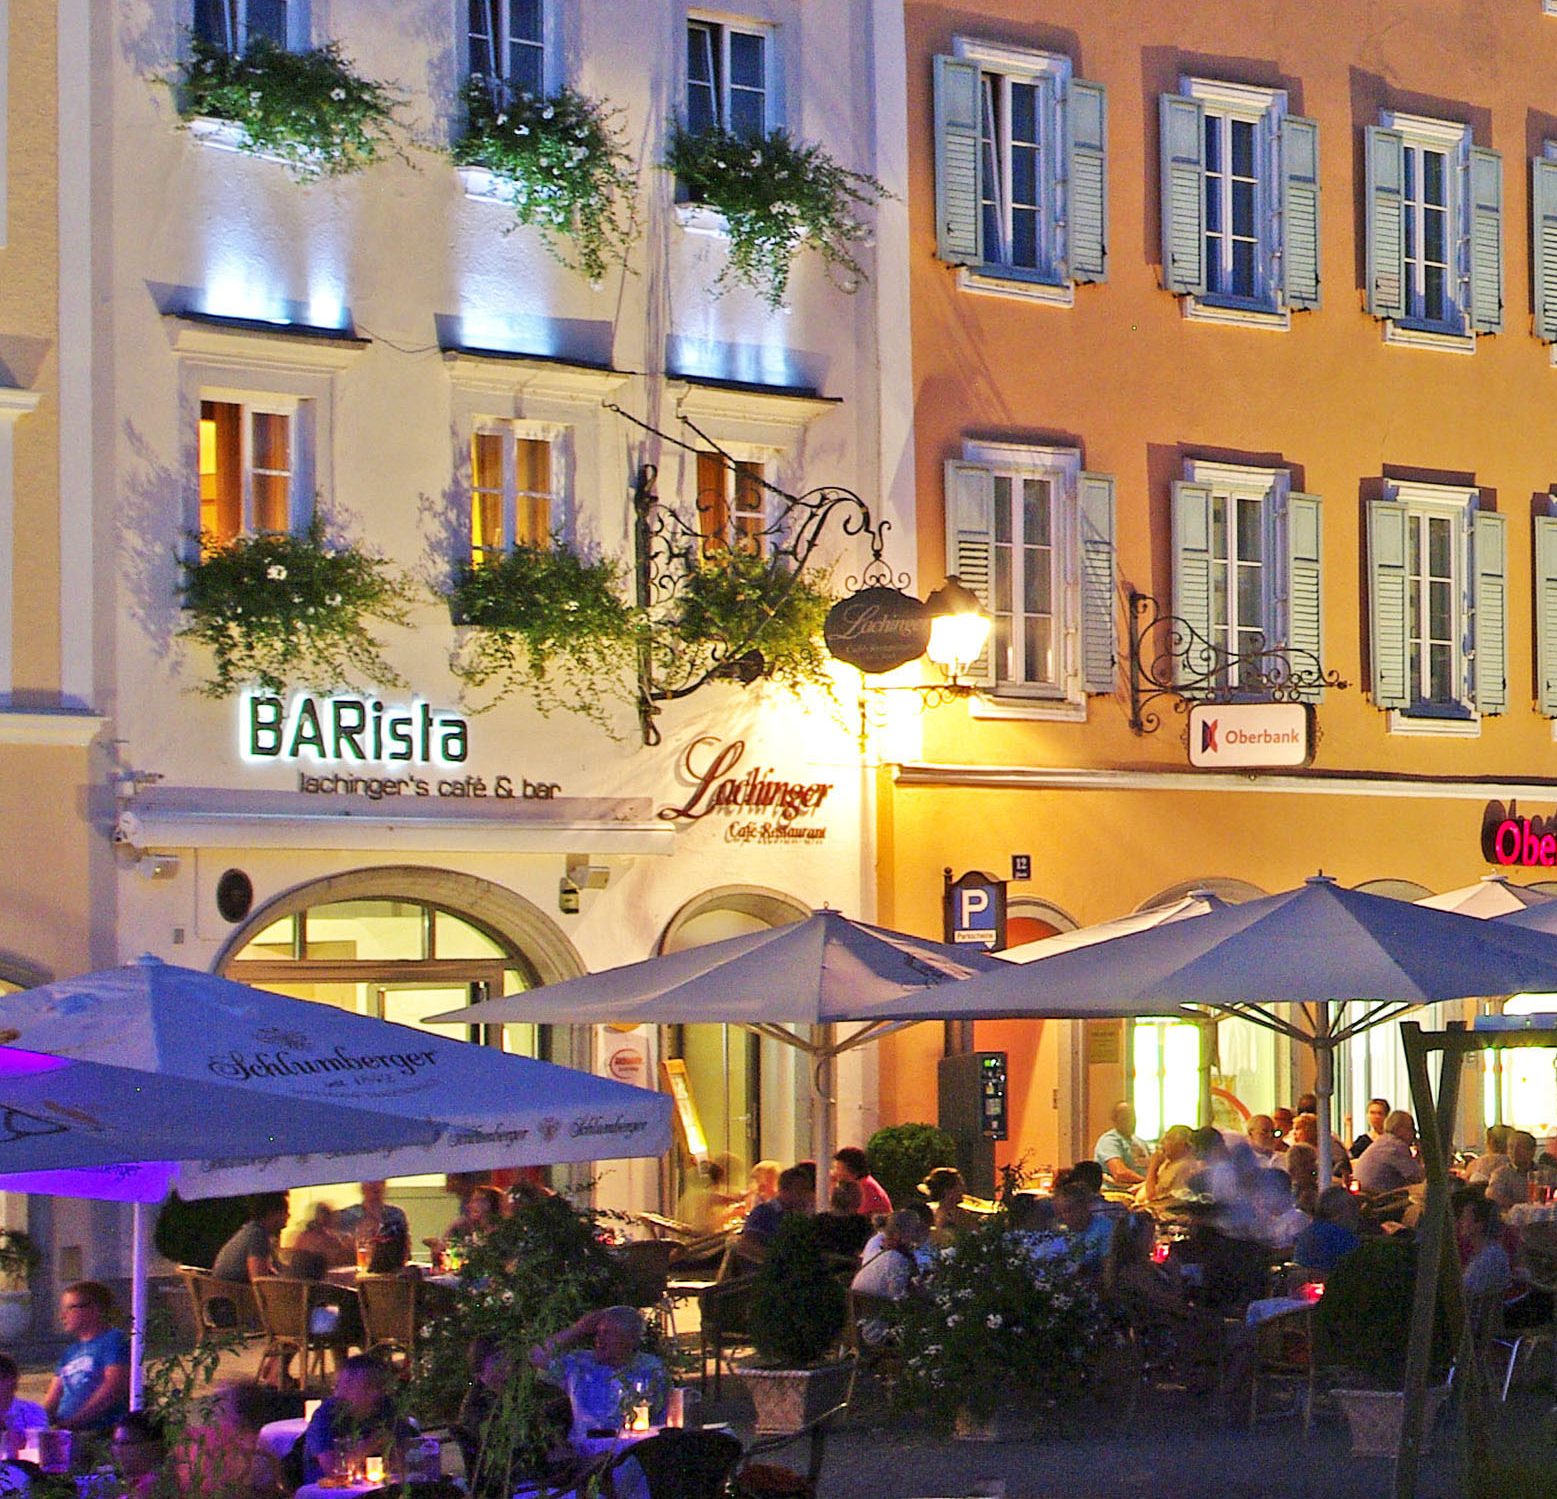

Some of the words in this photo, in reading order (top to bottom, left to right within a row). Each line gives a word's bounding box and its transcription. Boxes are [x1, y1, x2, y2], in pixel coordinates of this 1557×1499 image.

[250, 696, 467, 762] BARista
[1225, 728, 1299, 744] Oberbank
[299, 772, 429, 799] lachinger's
[438, 775, 486, 797] café
[495, 777, 513, 798] &
[522, 779, 562, 799] bar
[657, 736, 833, 820] Lachinger
[1015, 857, 1028, 869] 12
[962, 889, 988, 929] P
[208, 1046, 437, 1081] Schlumberger
